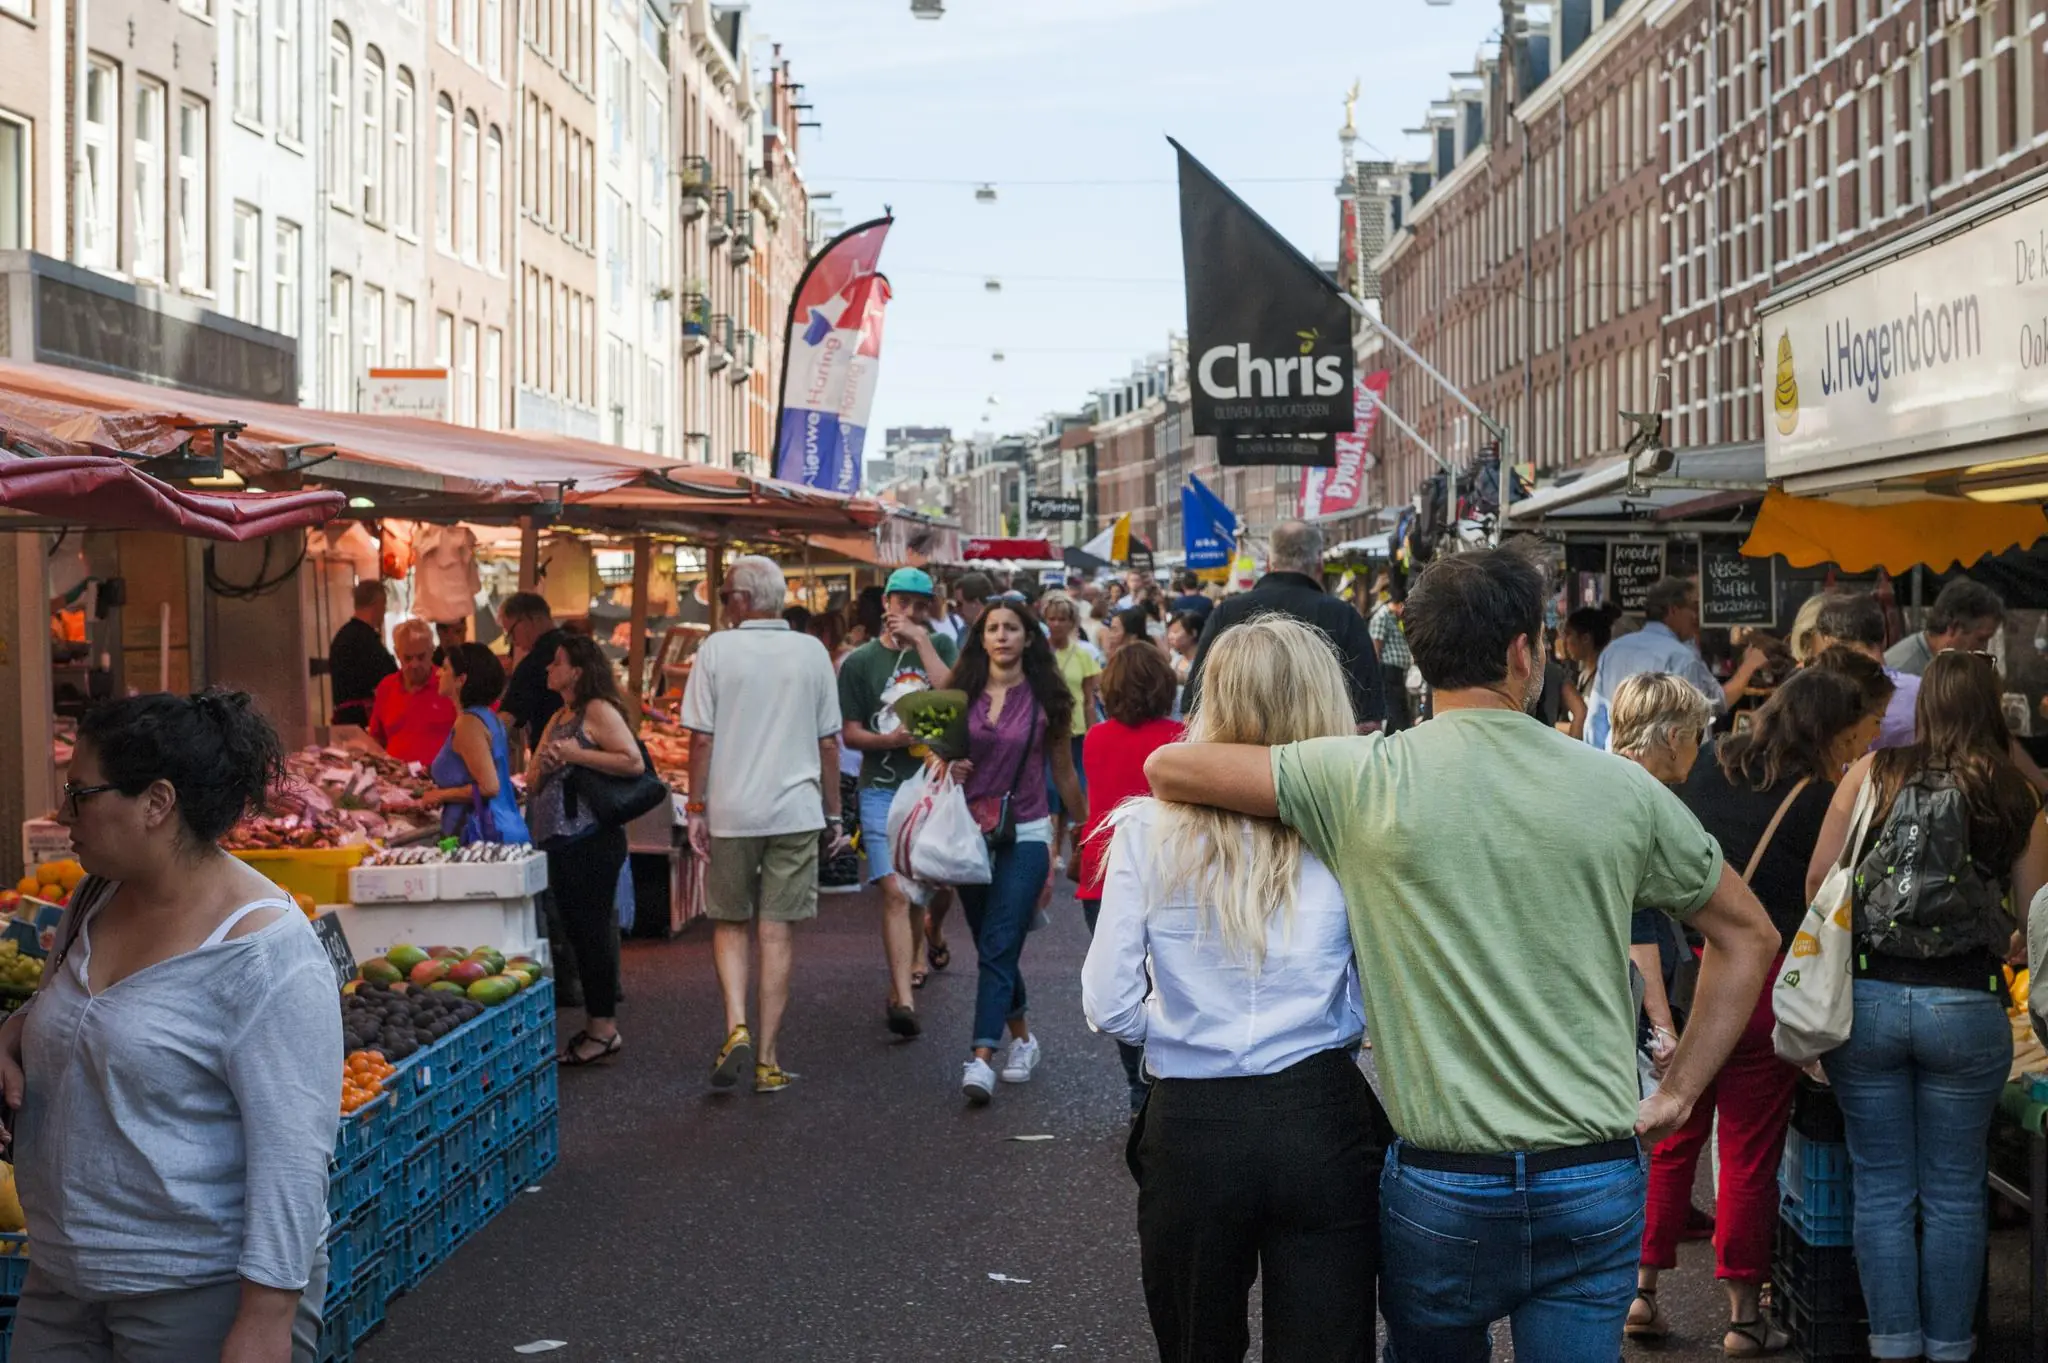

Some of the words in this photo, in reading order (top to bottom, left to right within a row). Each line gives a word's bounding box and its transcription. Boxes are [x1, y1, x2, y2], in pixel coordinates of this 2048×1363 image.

[2014, 239, 2035, 286] De
[806, 337, 842, 405] Haring
[1198, 343, 1344, 399] Chris
[1265, 403, 1330, 420] DELICATESSEN
